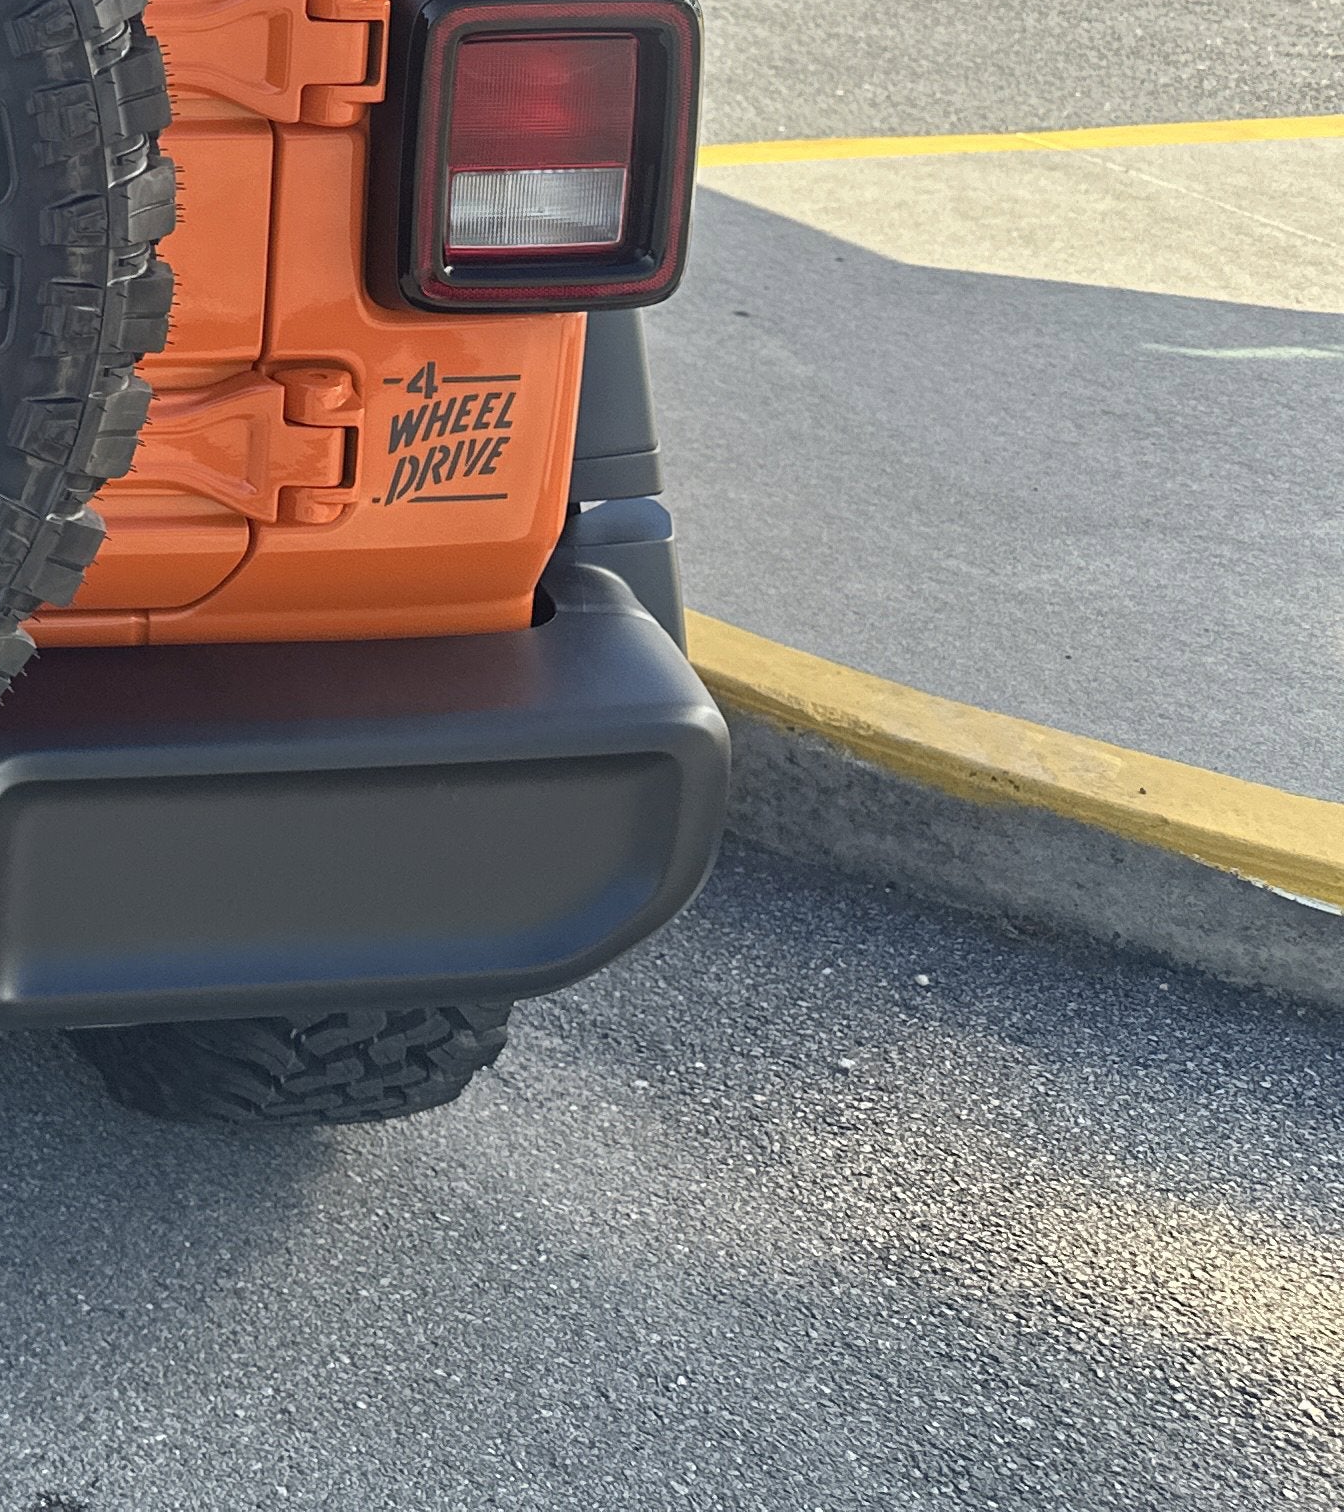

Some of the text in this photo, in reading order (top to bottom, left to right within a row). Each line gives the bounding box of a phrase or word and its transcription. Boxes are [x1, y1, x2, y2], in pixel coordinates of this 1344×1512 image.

[406, 361, 438, 399] 4
[388, 392, 517, 455] WHEEL
[384, 437, 511, 507] DRIVE
